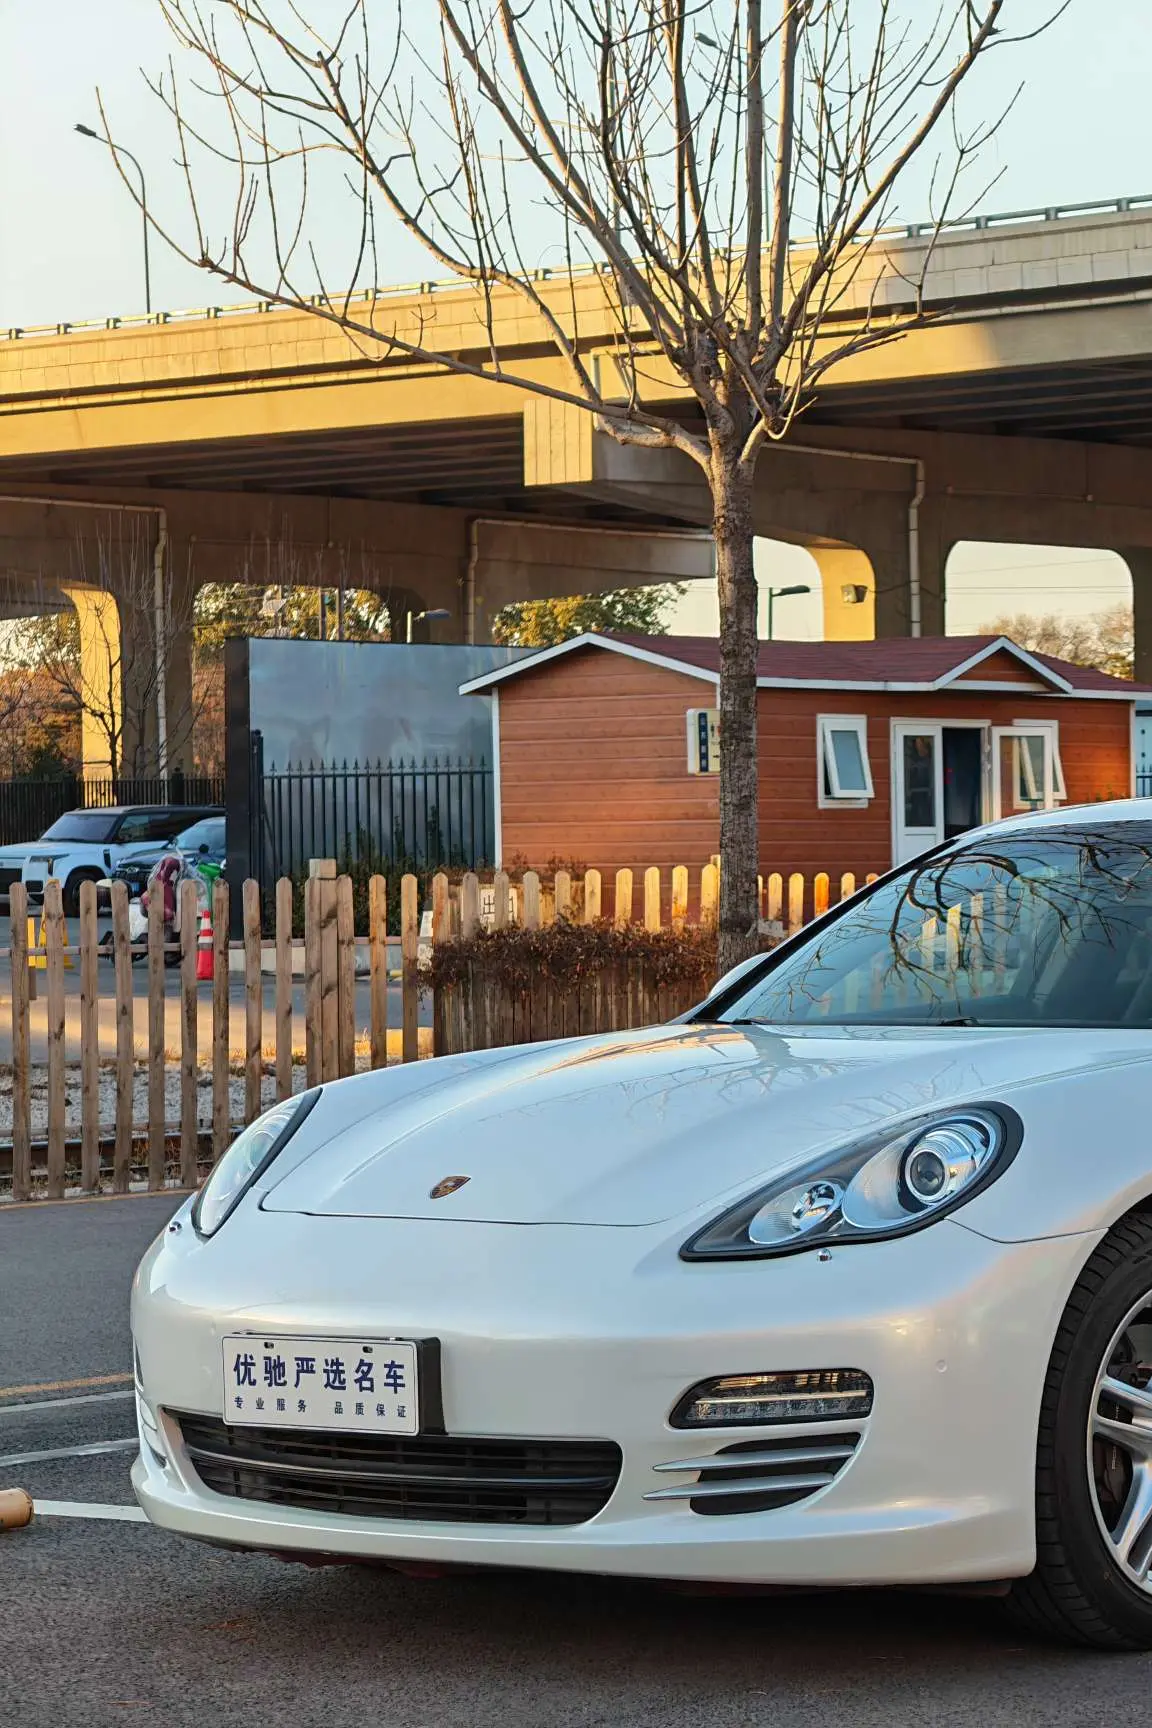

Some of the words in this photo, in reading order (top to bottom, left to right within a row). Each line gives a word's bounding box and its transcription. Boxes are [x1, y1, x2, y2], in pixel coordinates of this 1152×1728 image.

[233, 1353, 406, 1394] 优驰严选名车
[234, 1396, 307, 1413] 专业服务
[334, 1401, 407, 1418] 品质保证
